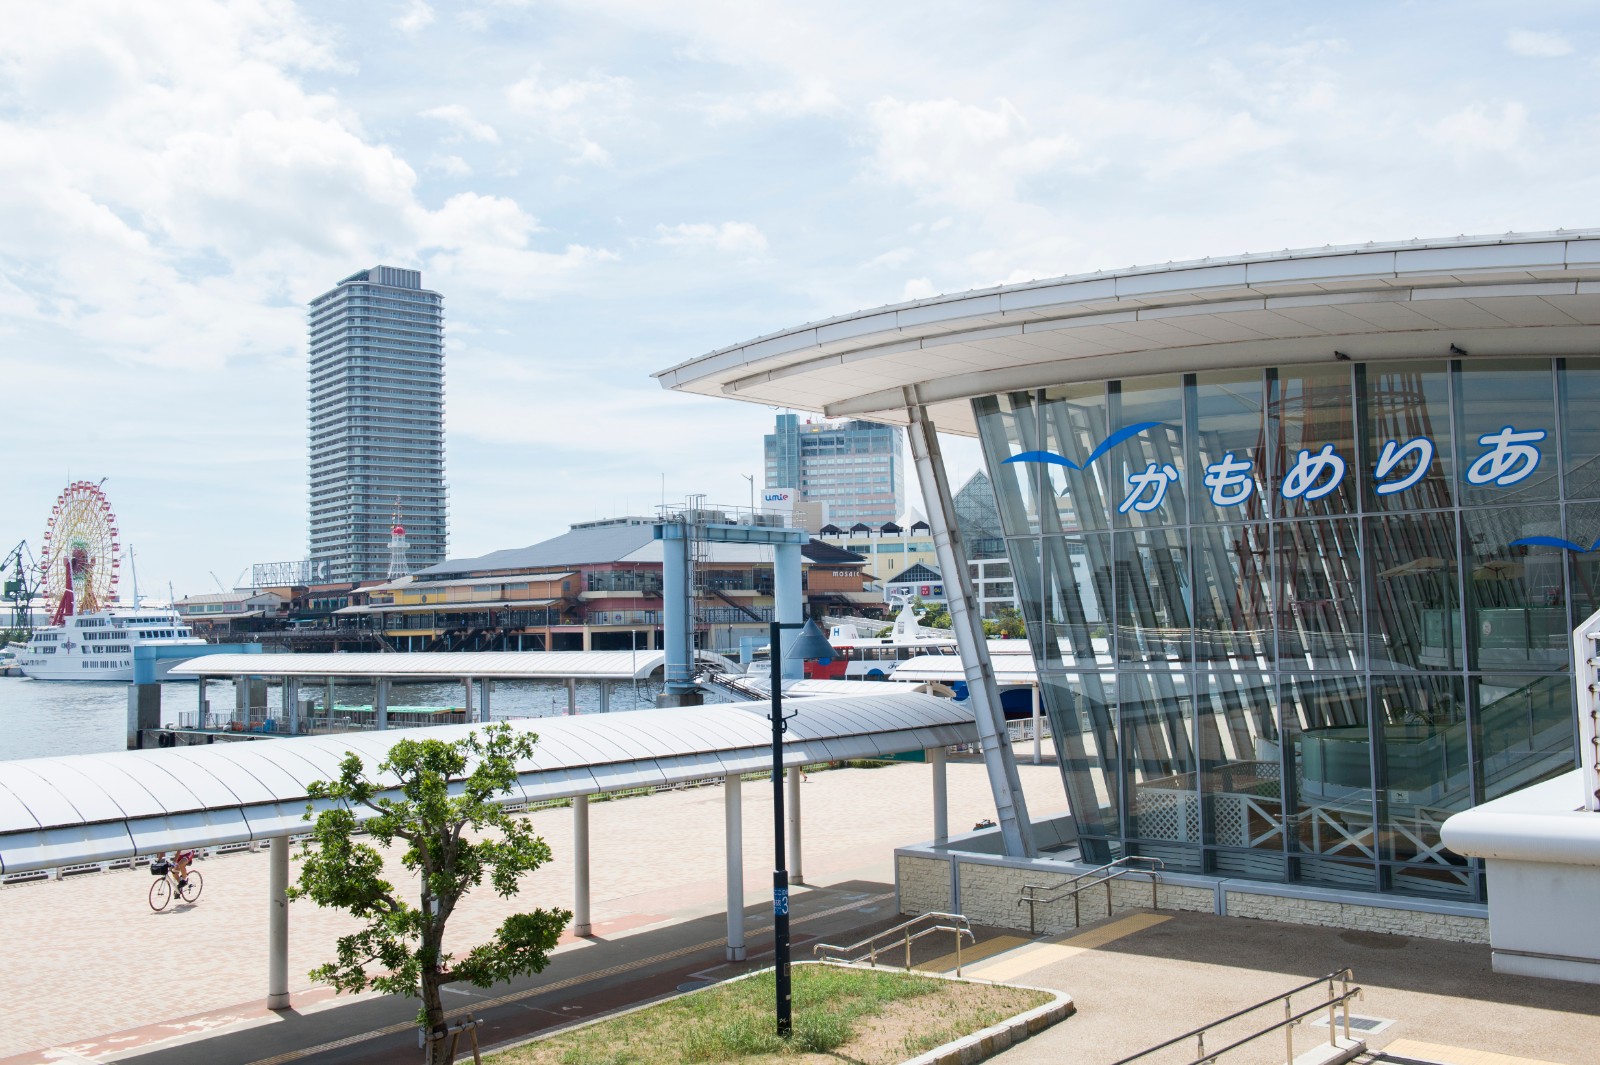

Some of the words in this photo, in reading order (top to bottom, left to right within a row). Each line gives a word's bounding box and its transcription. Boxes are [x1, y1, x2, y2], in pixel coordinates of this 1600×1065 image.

[1118, 425, 1548, 513] かもめりあ
[833, 628, 840, 636] H
[782, 896, 788, 914] 3
